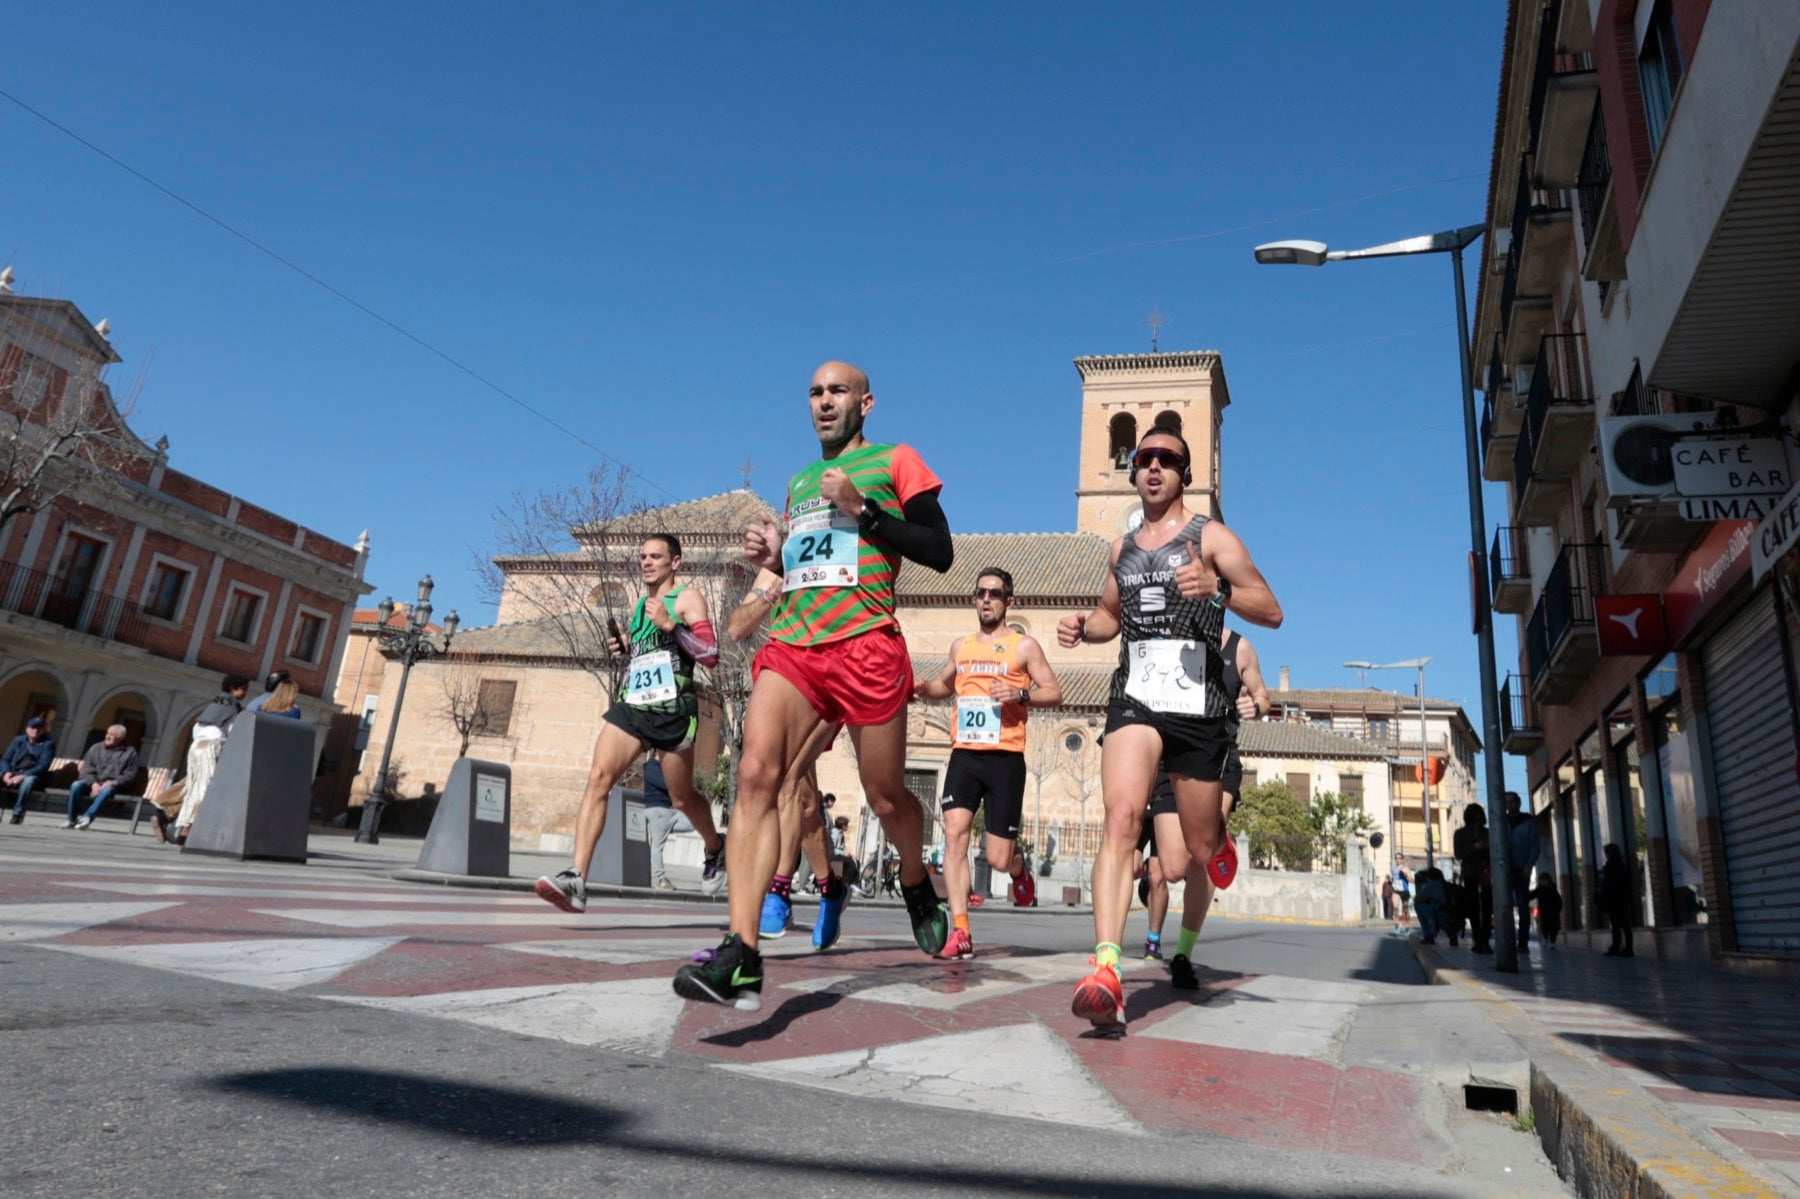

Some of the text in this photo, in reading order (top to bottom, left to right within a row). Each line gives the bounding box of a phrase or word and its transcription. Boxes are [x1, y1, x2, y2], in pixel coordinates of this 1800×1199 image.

[1677, 444, 1752, 466] CAFÉ
[1729, 470, 1785, 488] BAR
[799, 533, 833, 563] 24
[1703, 520, 1754, 593] Seguros Bilbao
[1122, 571, 1177, 586] TRIATARF
[1131, 615, 1176, 625] SEAT
[635, 667, 663, 690] 231
[966, 711, 986, 728] 20
